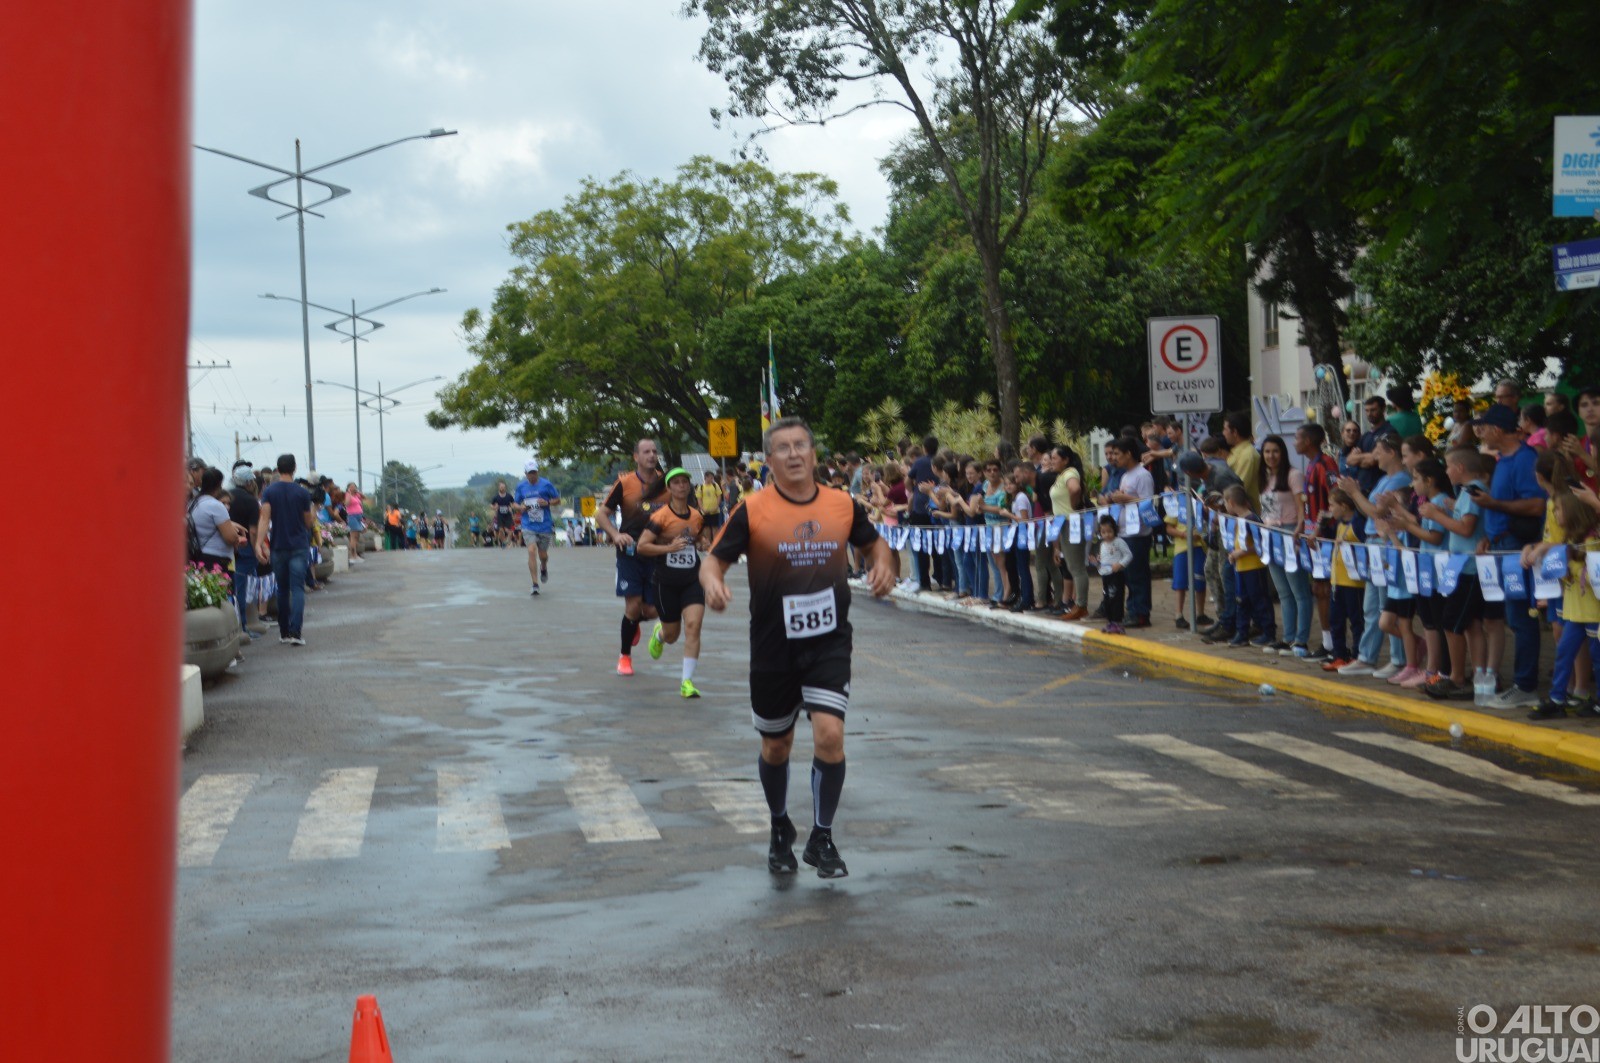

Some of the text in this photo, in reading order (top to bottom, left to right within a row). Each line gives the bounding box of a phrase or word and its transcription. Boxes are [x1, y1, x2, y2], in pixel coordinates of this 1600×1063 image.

[1176, 337, 1192, 361] E
[1157, 380, 1215, 391] EXCLUSIVO
[1175, 393, 1198, 403] TÁXI
[778, 540, 838, 552] Med Forma
[670, 553, 694, 565] 553
[790, 606, 833, 632] 585
